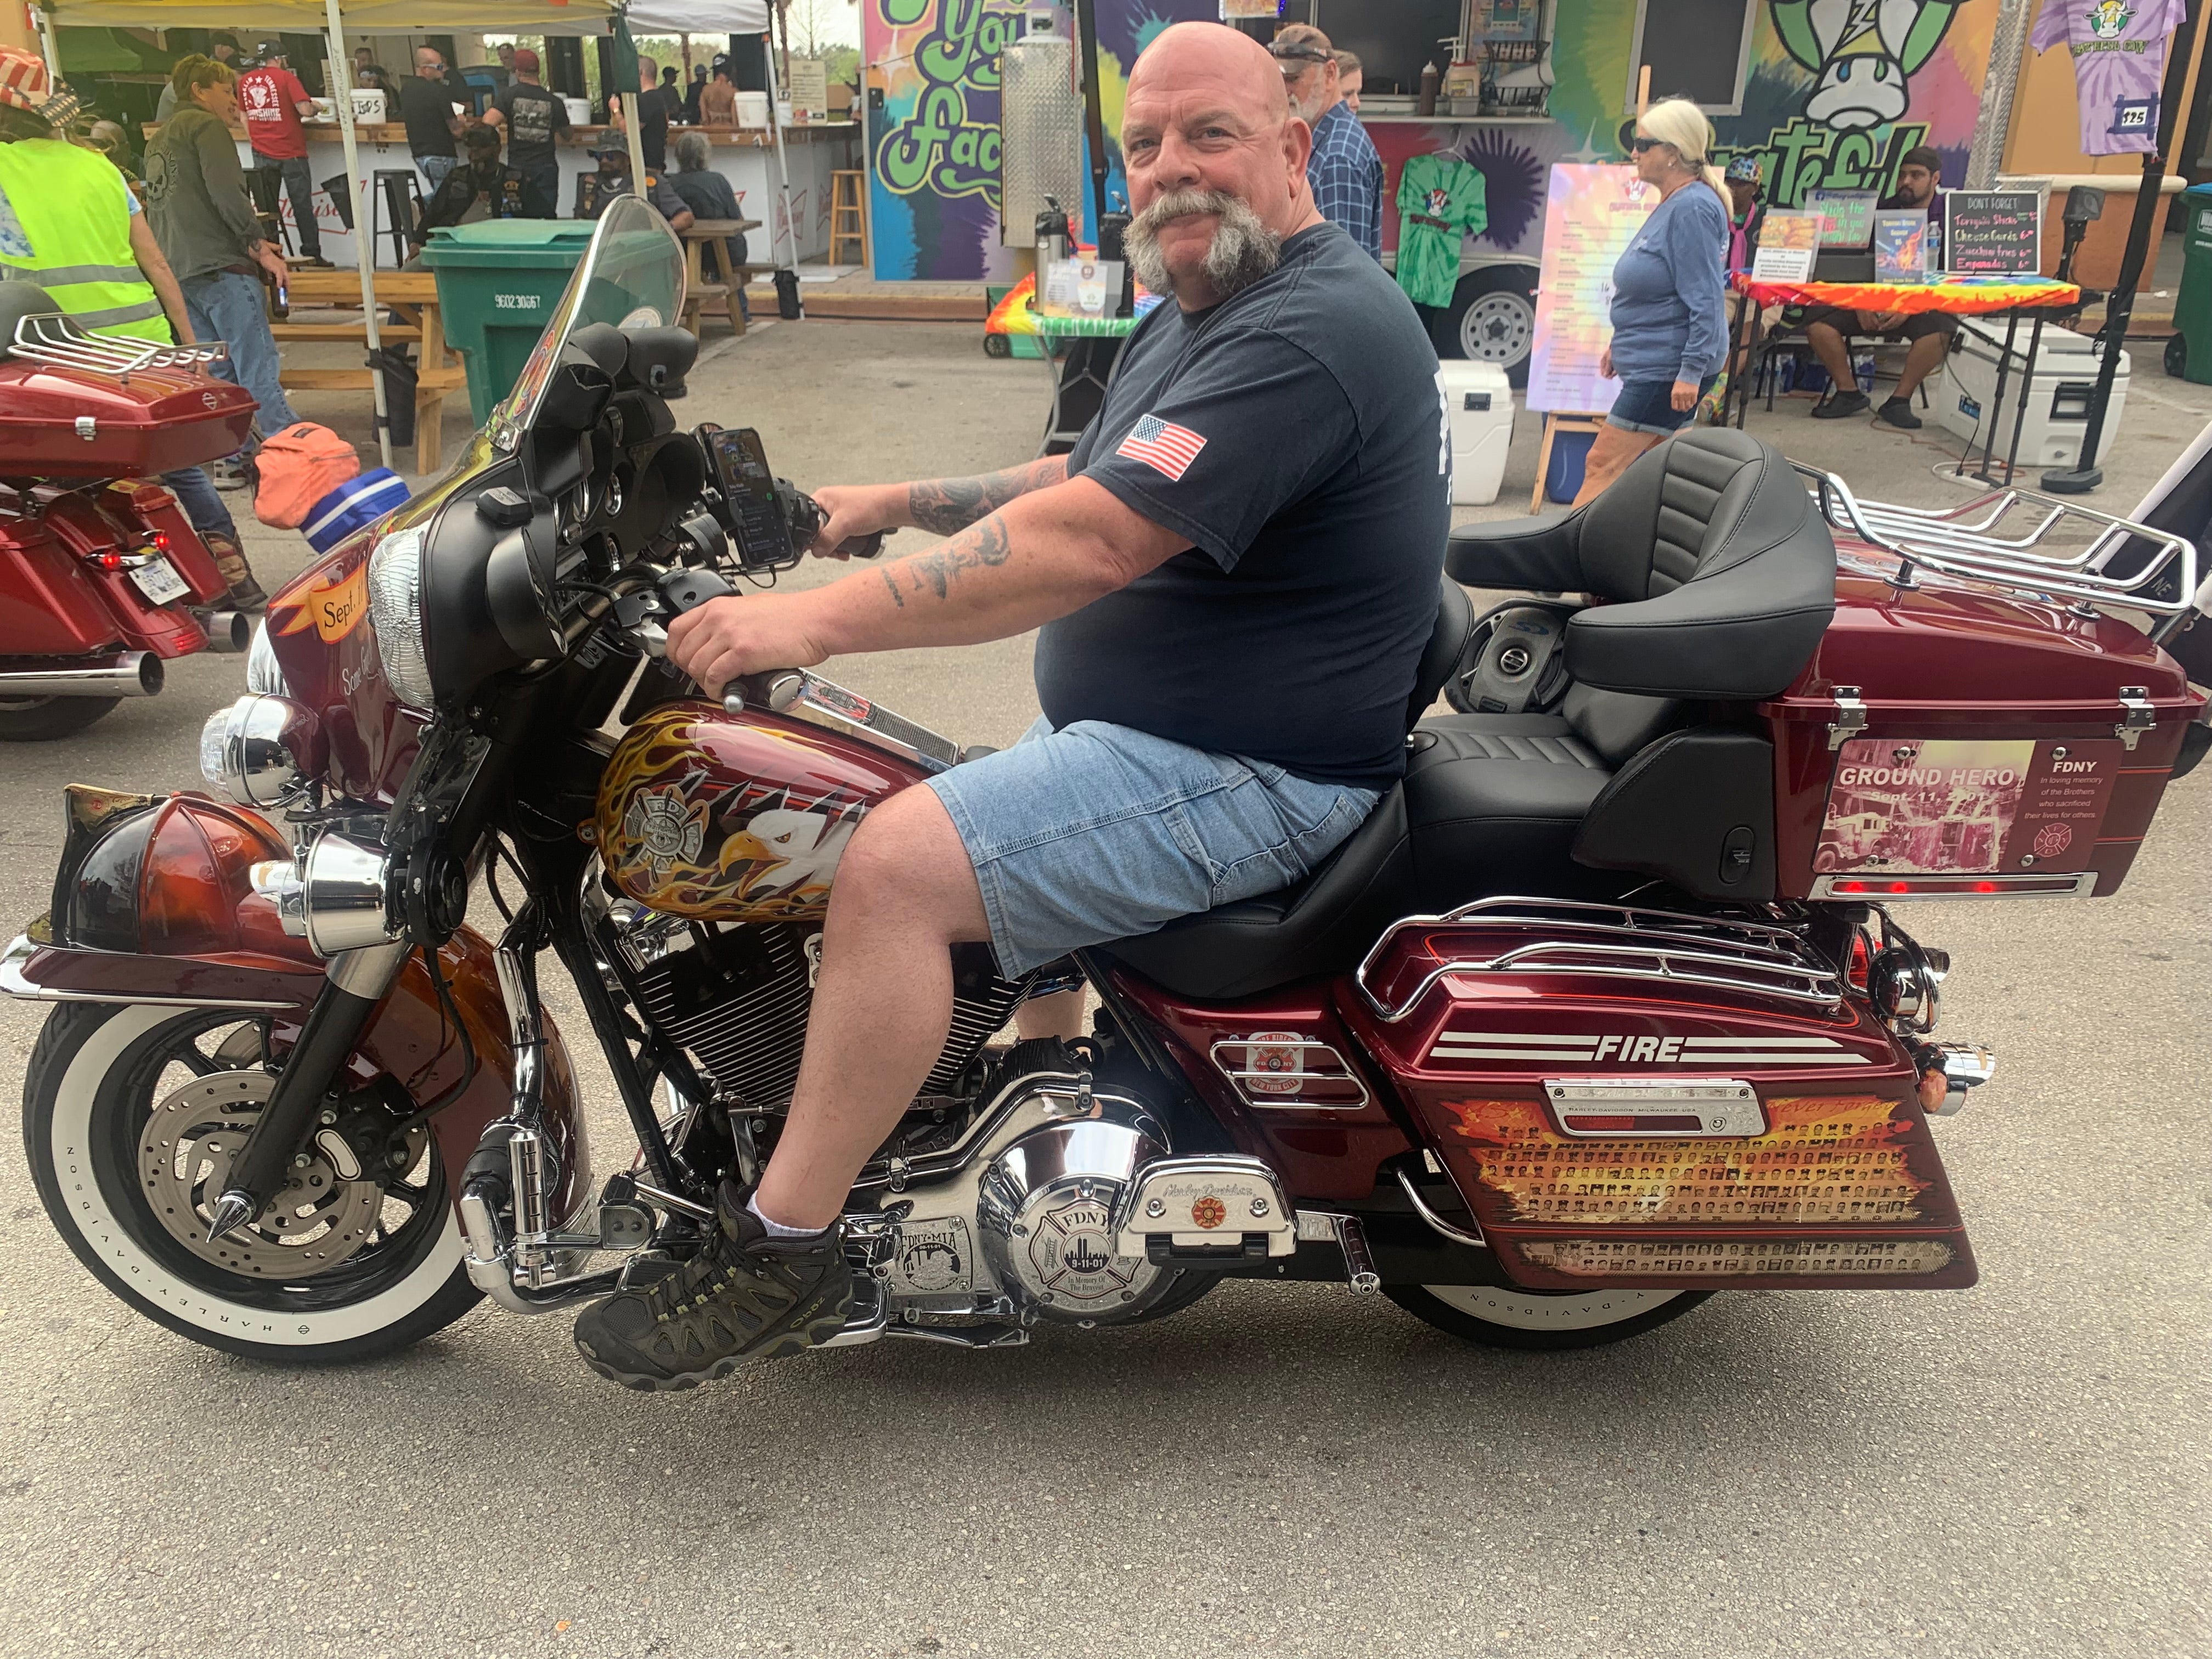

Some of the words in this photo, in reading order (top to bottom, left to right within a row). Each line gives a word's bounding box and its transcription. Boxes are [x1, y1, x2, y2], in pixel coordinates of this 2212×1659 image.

[2123, 39, 2149, 54] COW
[2123, 111, 2145, 124] $25
[324, 589, 357, 630] Sept.
[2052, 761, 2097, 773] FDNY
[1839, 768, 1942, 786] GROUND
[1949, 769, 2014, 786] HERO
[2049, 777, 2072, 785] loving
[2073, 777, 2103, 785] memory
[1871, 792, 1911, 803] Sept.
[1920, 792, 1942, 803] 11,
[1594, 1035, 1685, 1063] FIRE
[1252, 1078, 1266, 1089] NEW
[1283, 1079, 1296, 1090] CITY
[1062, 1211, 1109, 1228] FDNY
[67, 1146, 273, 1331] HARLEY-DAVIDSON
[1071, 1259, 1103, 1268] 9-11-01
[1531, 1254, 1583, 1267] FDNY
[1076, 1276, 1098, 1285] Memory
